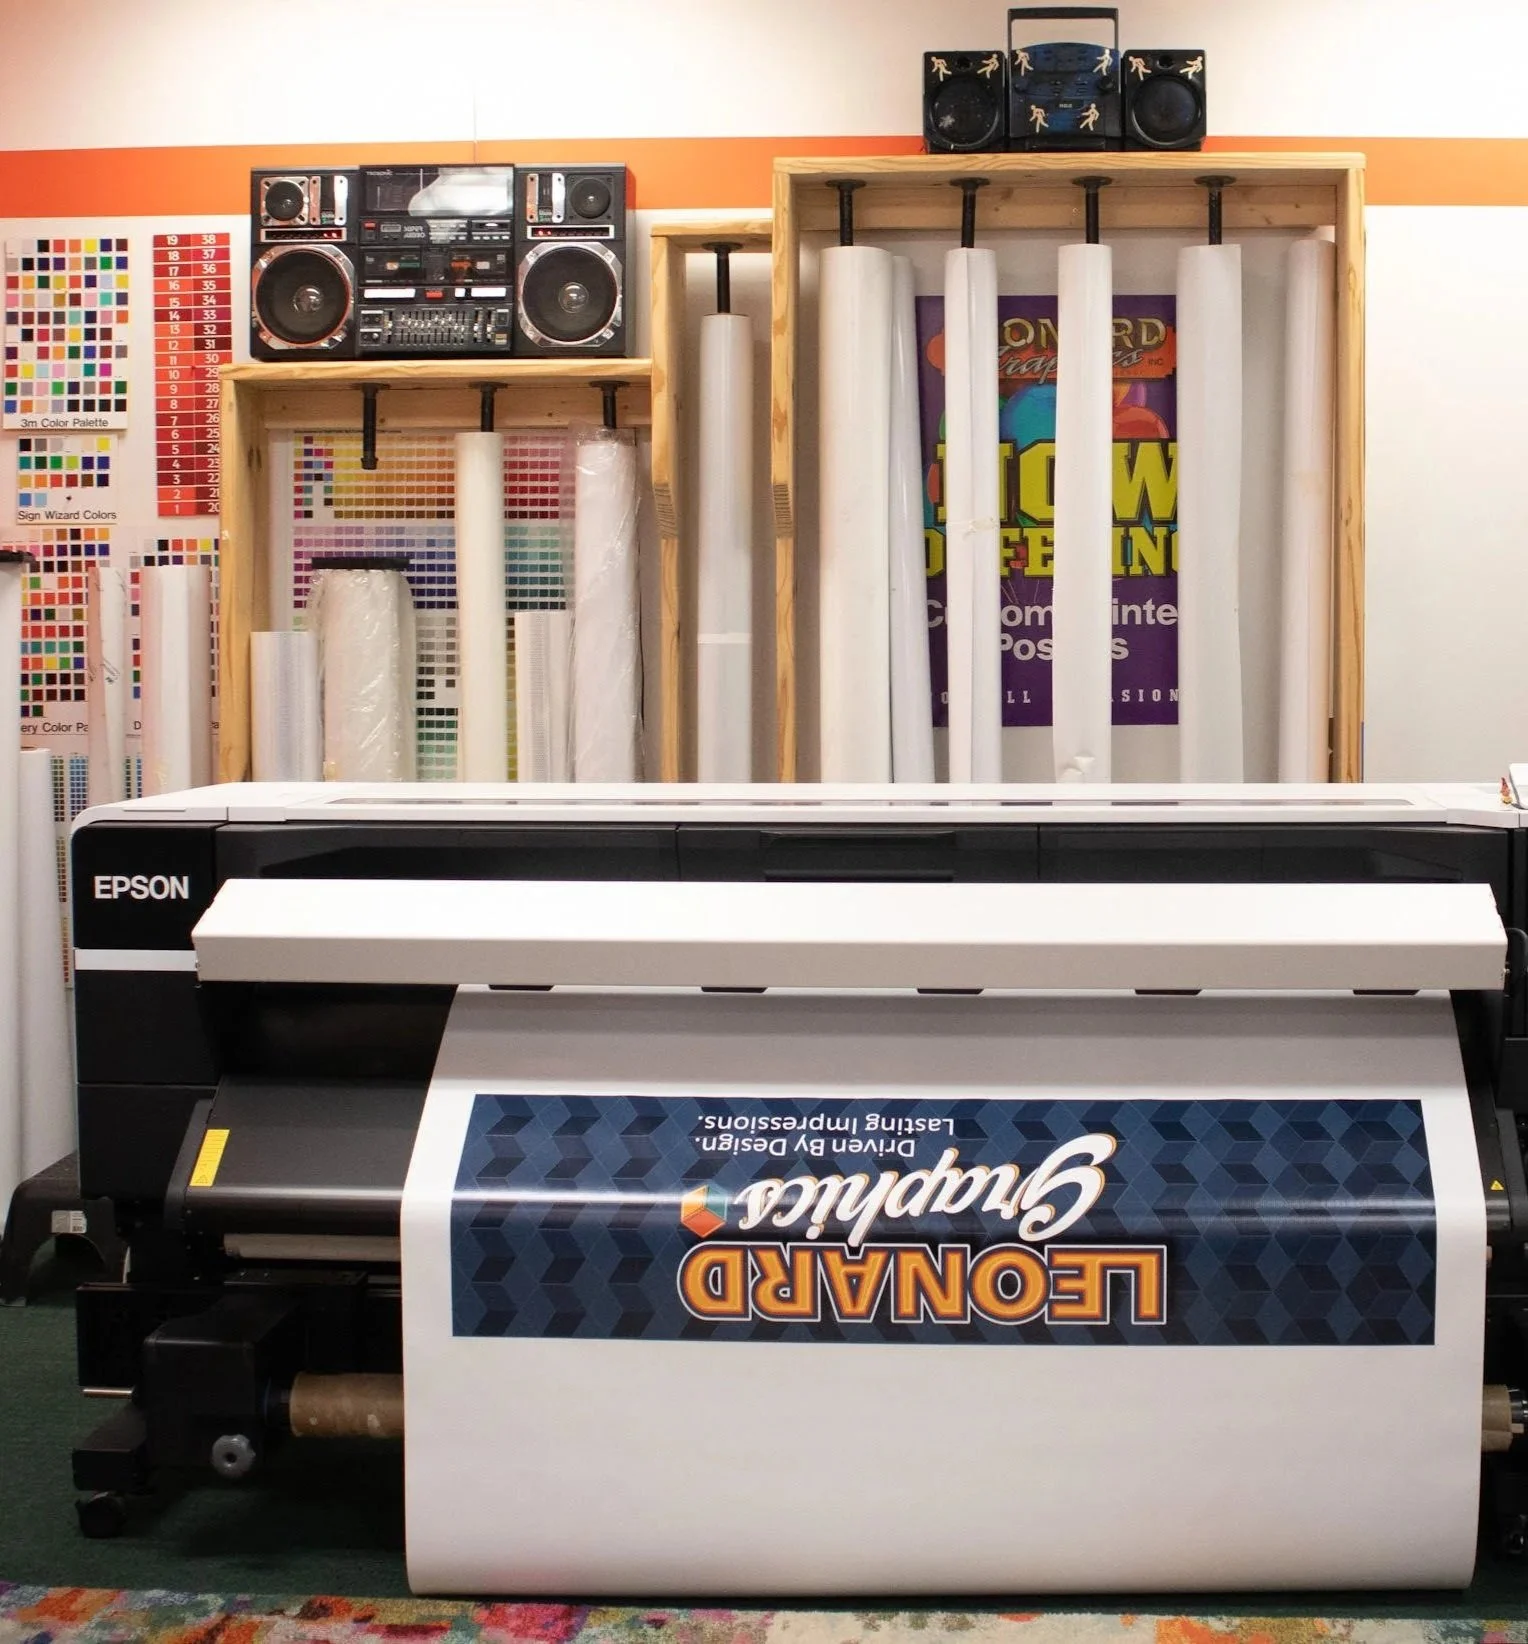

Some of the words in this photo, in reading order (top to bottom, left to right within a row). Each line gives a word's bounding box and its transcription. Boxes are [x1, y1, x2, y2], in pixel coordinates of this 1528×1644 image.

[166, 235, 178, 246] 19
[201, 234, 216, 244] 38
[168, 251, 180, 261] 18
[202, 249, 215, 260] 37
[168, 266, 179, 276] 17
[202, 264, 216, 274] 36
[168, 280, 180, 290] 16
[202, 281, 216, 291] 35
[169, 297, 180, 307] 15
[202, 295, 216, 305] 34
[169, 311, 180, 321] 14
[203, 310, 217, 320] 33
[170, 325, 180, 334] 13
[203, 325, 217, 335] 32
[1003, 317, 1166, 348] ONRD
[168, 340, 179, 350] 12
[205, 339, 215, 349] 31
[169, 356, 177, 365] 11
[205, 354, 219, 363] 30
[1148, 358, 1164, 366] INC
[169, 370, 179, 380] 10
[205, 367, 220, 378] 29
[169, 384, 178, 394] 9
[205, 383, 220, 393] 28
[169, 399, 178, 409] 8
[206, 399, 219, 409] 27
[21, 419, 37, 428] 3m
[41, 418, 69, 428] Color
[72, 418, 108, 427] Palette
[170, 416, 178, 426] 7
[206, 413, 220, 423] 26
[171, 429, 180, 439] 6
[206, 428, 220, 438] 25
[171, 445, 180, 455] 5
[207, 443, 220, 453] 24
[172, 459, 180, 469] 4
[172, 475, 180, 485] 3
[173, 489, 181, 499] 2
[18, 510, 40, 521] Sign
[45, 510, 80, 520] Wizard
[83, 510, 117, 520] Colors
[1000, 633, 1129, 660] Poss
[42, 722, 72, 732] Color
[94, 875, 189, 900] EPSON
[698, 1113, 857, 1136] Impressions.
[865, 1113, 954, 1135] Lasting
[695, 1135, 787, 1156] Design.
[794, 1134, 824, 1156] By
[831, 1136, 916, 1157] Driven
[733, 1133, 1117, 1247] Graphics
[677, 1241, 1167, 1325] LEONARD
